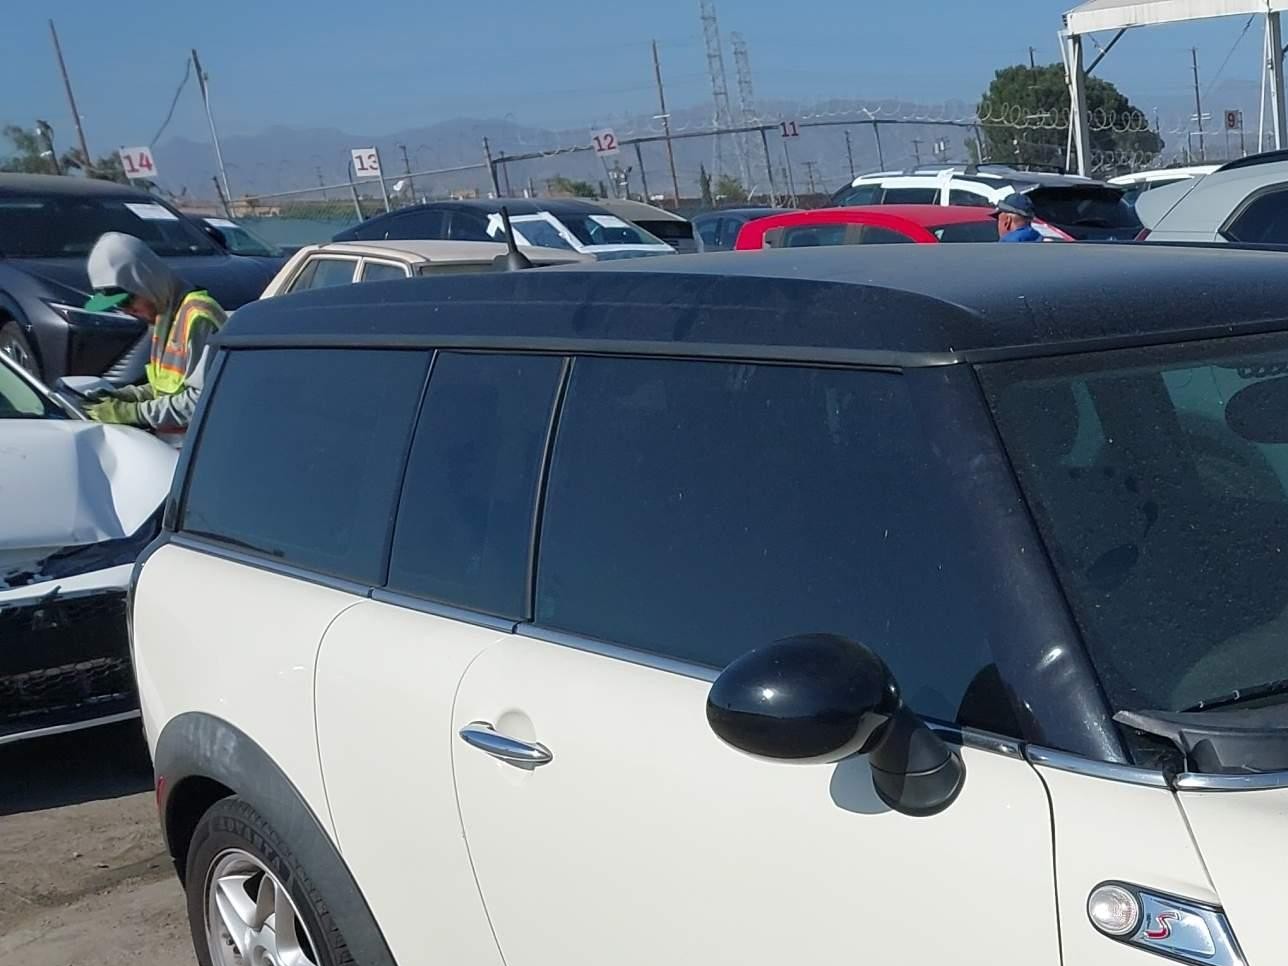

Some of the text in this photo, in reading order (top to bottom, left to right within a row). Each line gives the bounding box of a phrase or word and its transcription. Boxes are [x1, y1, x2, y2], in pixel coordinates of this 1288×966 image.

[780, 121, 799, 137] 11
[1227, 112, 1236, 128] 9
[593, 134, 616, 152] 12
[123, 152, 152, 173] 14
[354, 153, 378, 171] 13
[1143, 911, 1181, 940] S
